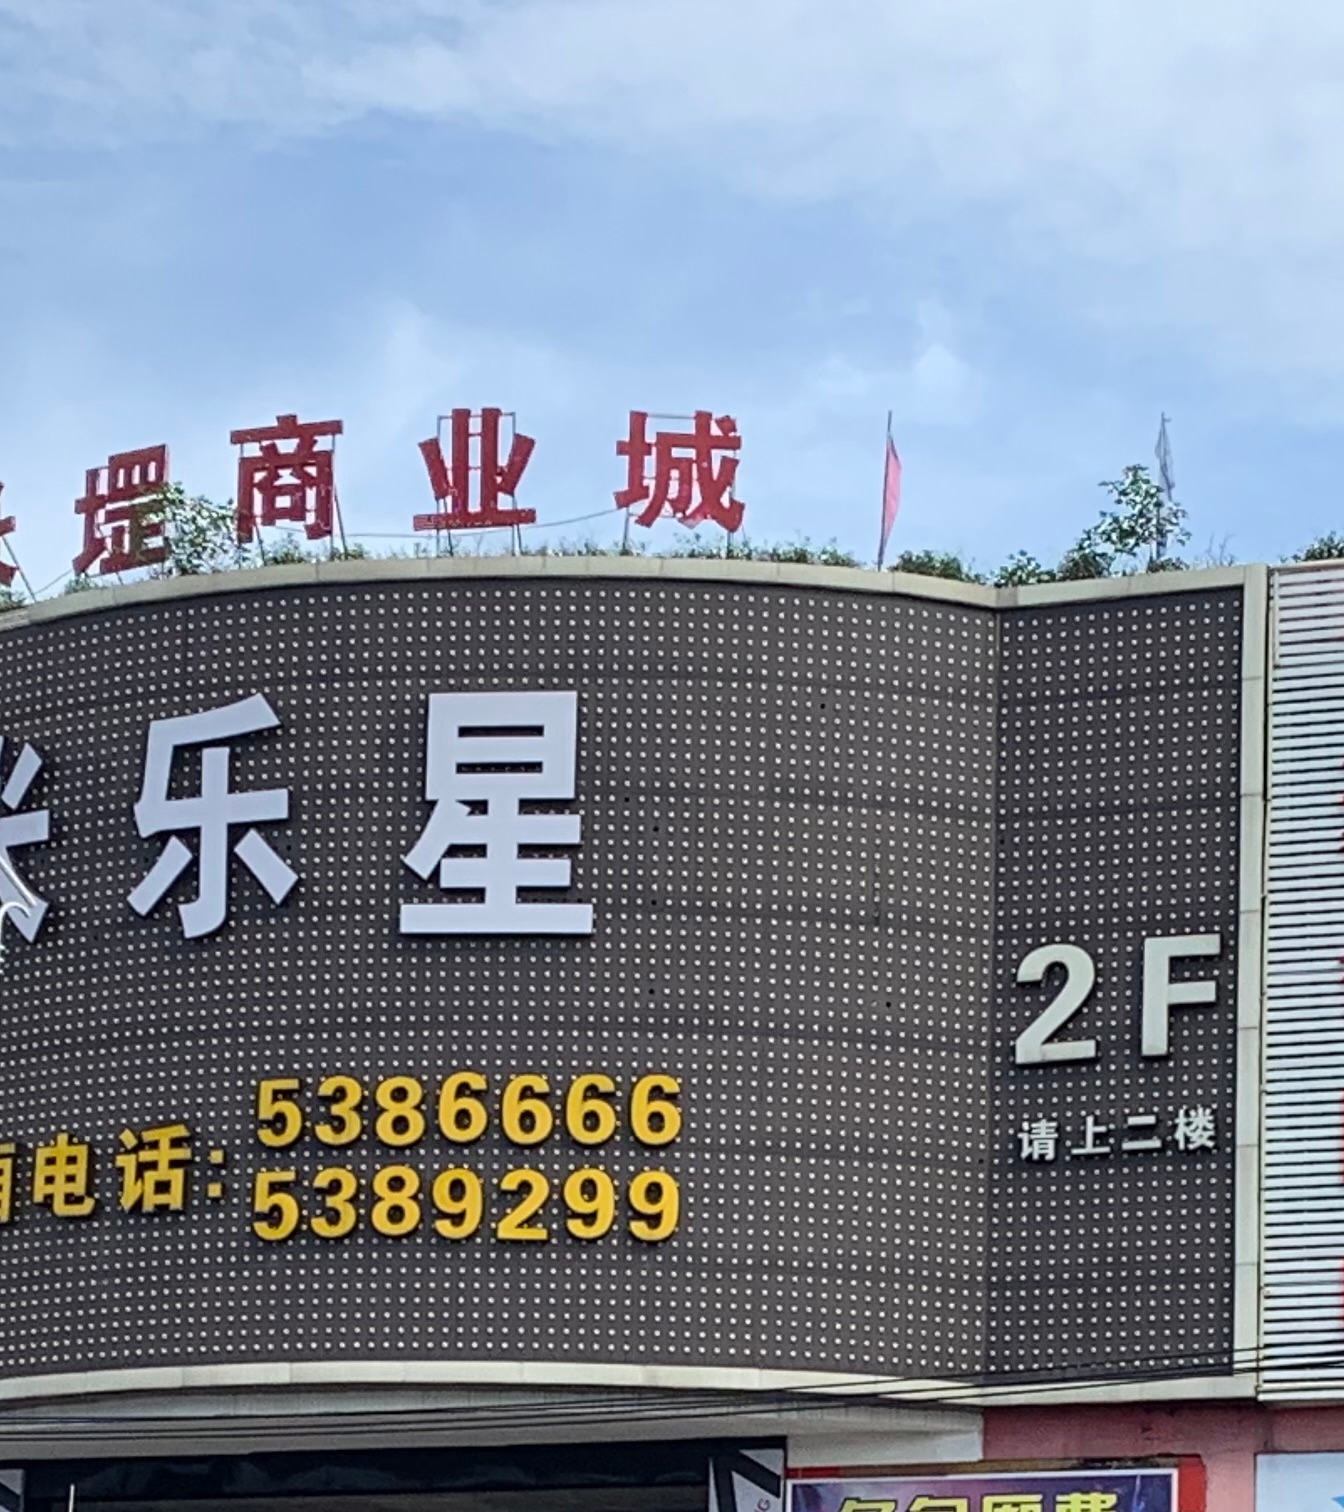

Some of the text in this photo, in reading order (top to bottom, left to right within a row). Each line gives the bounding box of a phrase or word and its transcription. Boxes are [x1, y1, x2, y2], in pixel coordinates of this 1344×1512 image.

[256, 1072, 682, 1147] 5386666
[1017, 1105, 1217, 1164] 请上二楼
[251, 1164, 681, 1242] 5389299
